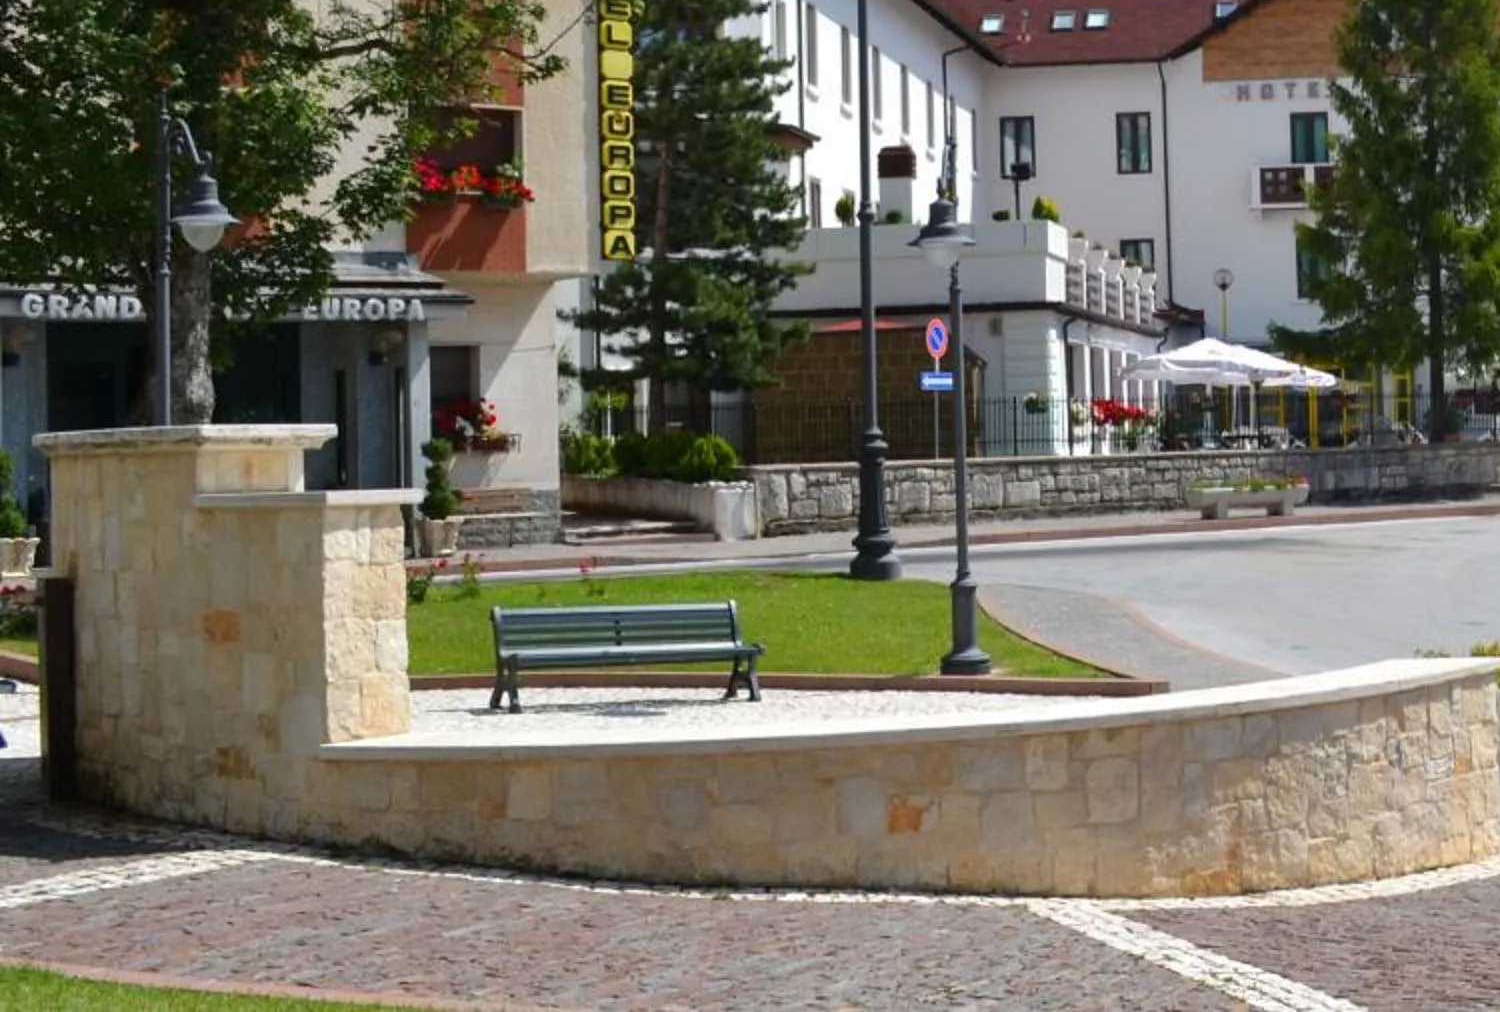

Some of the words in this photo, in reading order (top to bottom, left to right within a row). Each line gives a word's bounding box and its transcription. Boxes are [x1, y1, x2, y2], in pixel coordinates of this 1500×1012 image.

[1237, 81, 1334, 101] HOTE
[606, 84, 632, 256] EUROPA
[21, 293, 142, 319] GRAND
